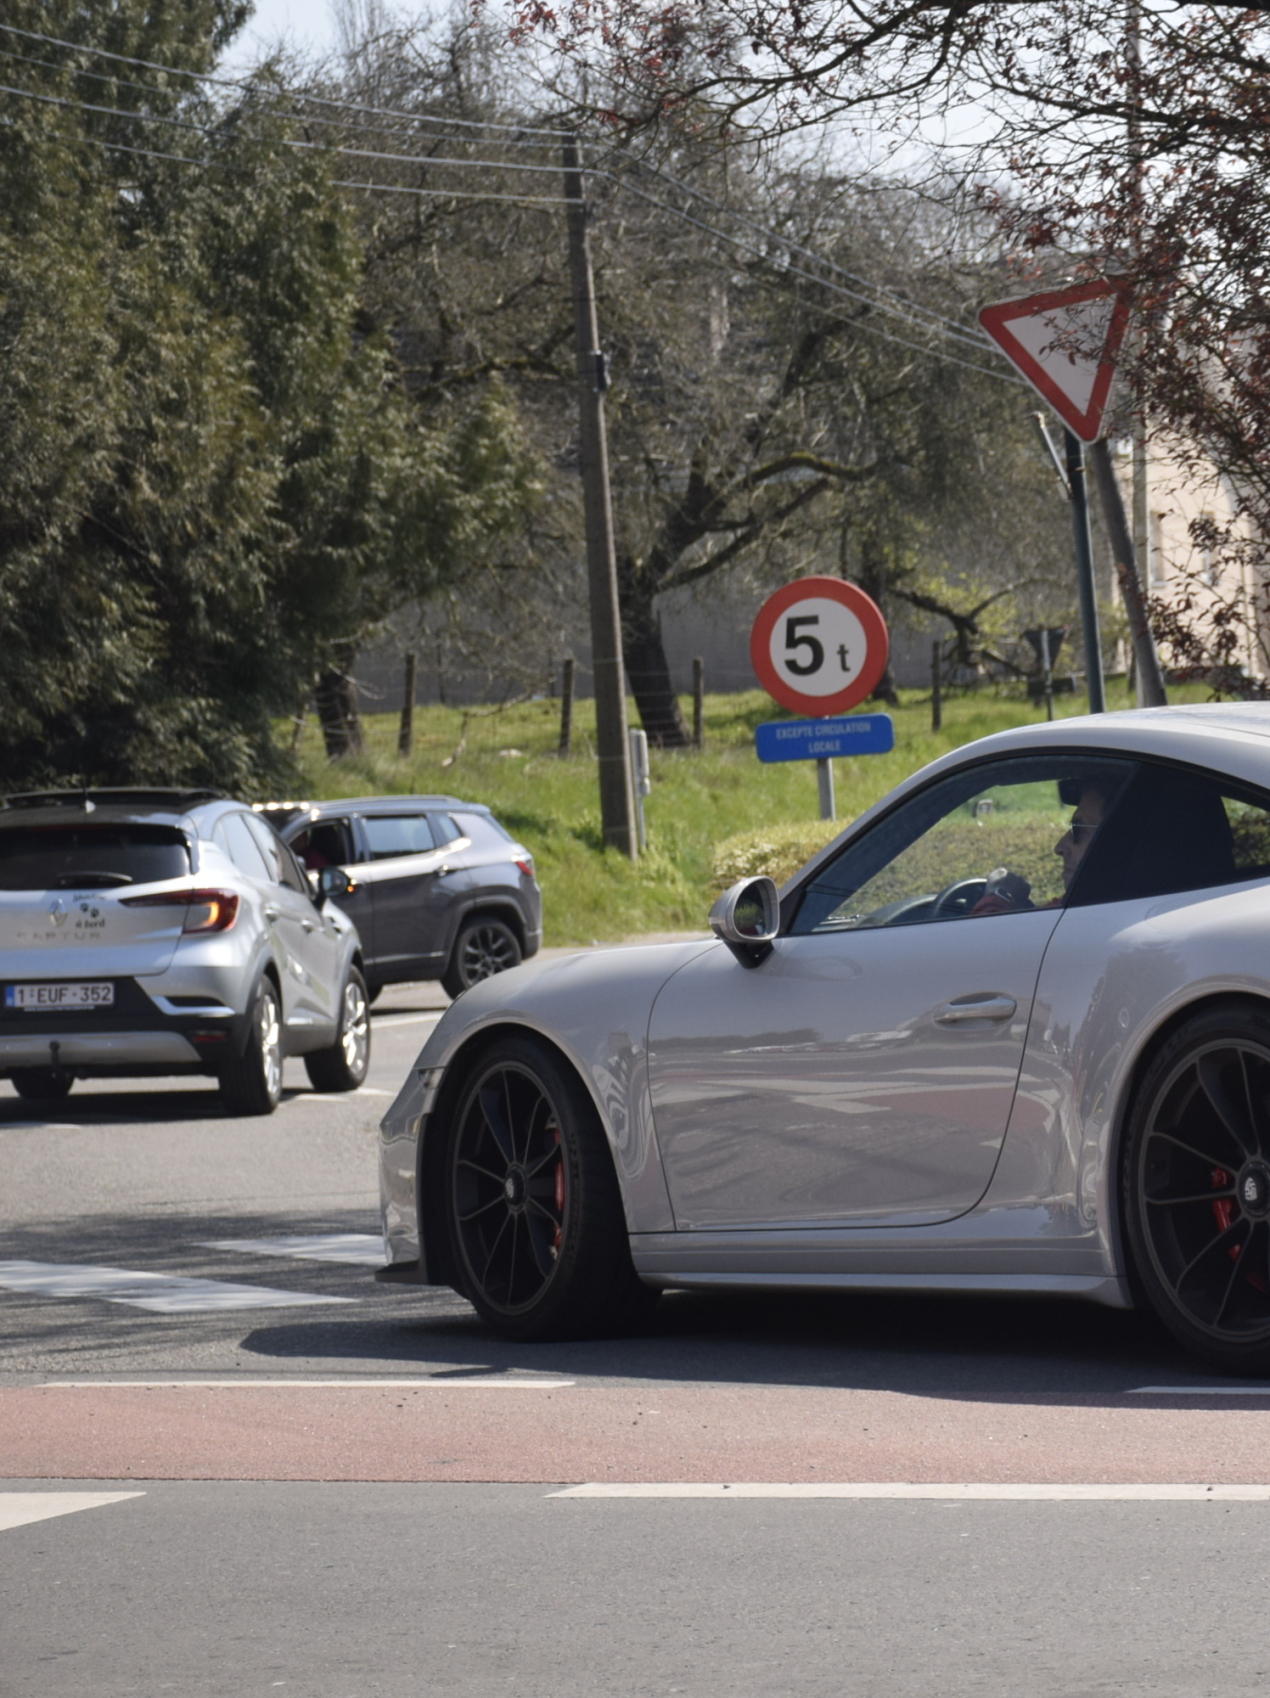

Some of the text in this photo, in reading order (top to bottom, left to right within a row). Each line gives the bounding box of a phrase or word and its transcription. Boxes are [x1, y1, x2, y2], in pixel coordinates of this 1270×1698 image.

[784, 614, 851, 677] 5 t
[814, 721, 871, 737] CIRCULATION
[808, 740, 841, 754] LOCALE
